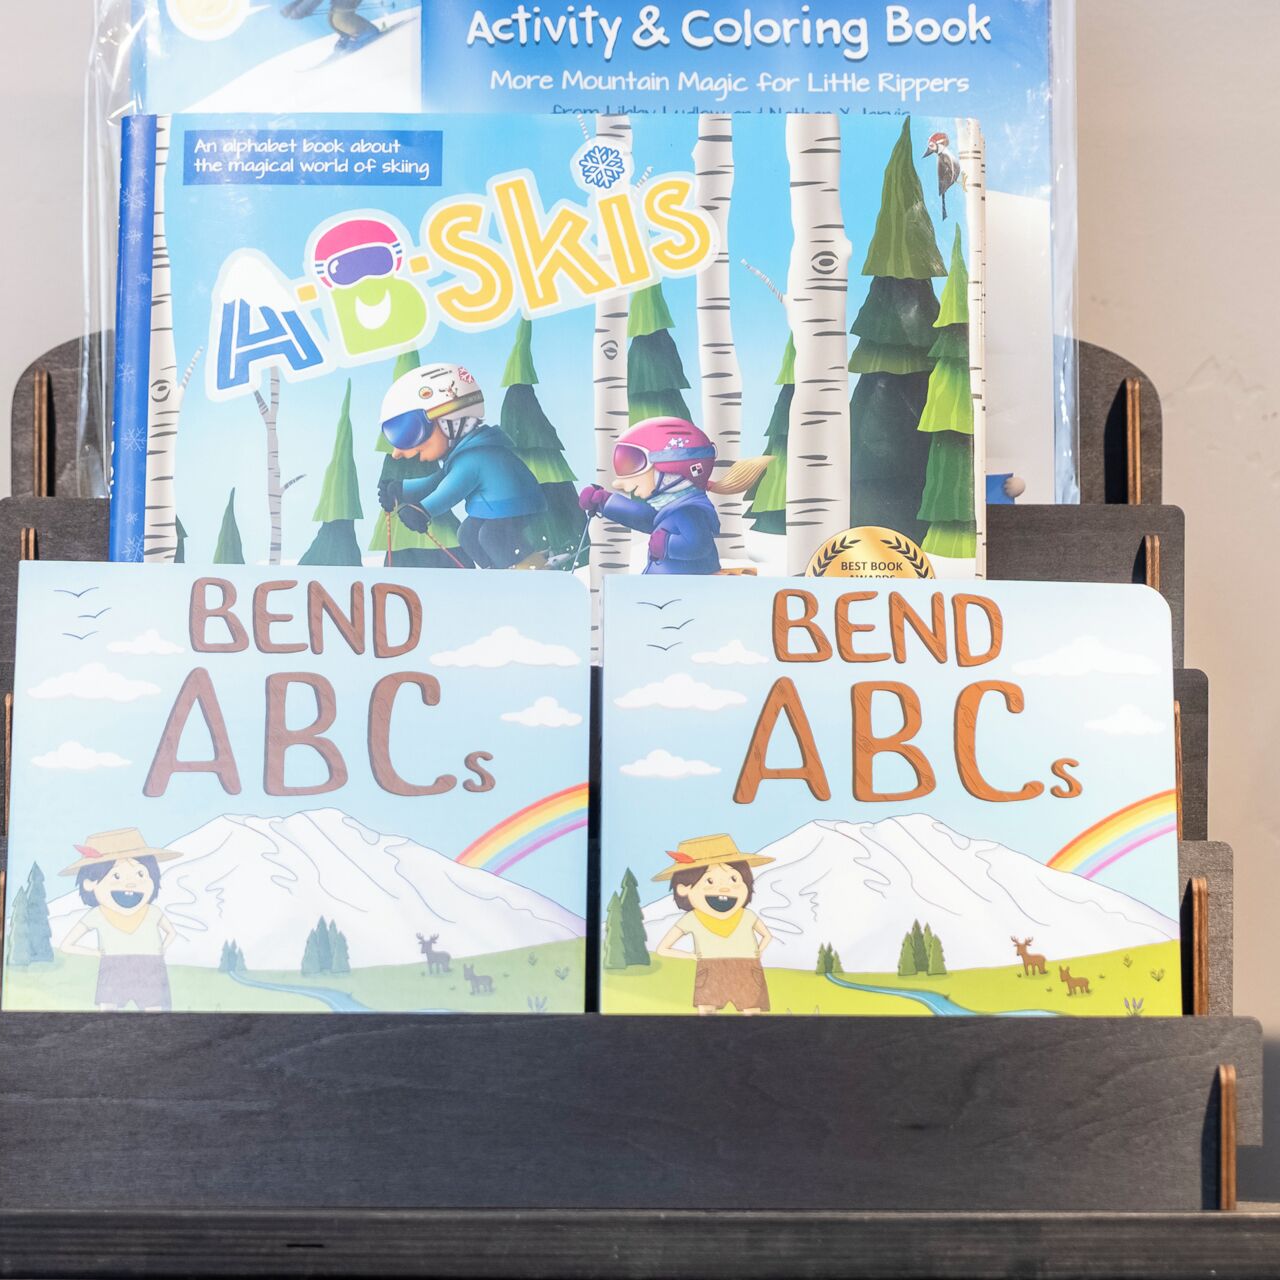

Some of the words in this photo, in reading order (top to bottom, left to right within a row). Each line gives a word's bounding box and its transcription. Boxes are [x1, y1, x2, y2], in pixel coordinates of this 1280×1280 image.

[466, 4, 622, 59] Activity
[632, 4, 670, 46] &
[681, 5, 869, 59] Coloring
[886, 4, 991, 43] Book
[490, 71, 553, 91] More
[562, 70, 669, 91] Mountain
[678, 72, 748, 101] Magic
[757, 72, 799, 92] for
[808, 72, 869, 93] Little
[878, 72, 970, 101] Rippers
[194, 139, 216, 152] An
[223, 139, 296, 158] alphabet
[303, 139, 345, 153] book
[350, 140, 400, 153] about
[194, 158, 222, 172] the
[229, 159, 294, 179] magical
[300, 159, 348, 172] world
[354, 158, 376, 172] of
[382, 160, 430, 180] skiing
[841, 561, 867, 571] BEST
[870, 561, 903, 571] BOOK
[189, 576, 425, 657] BEND
[771, 588, 1004, 667] BEND
[140, 667, 497, 798] ABCs
[733, 675, 1083, 803] ABCs
